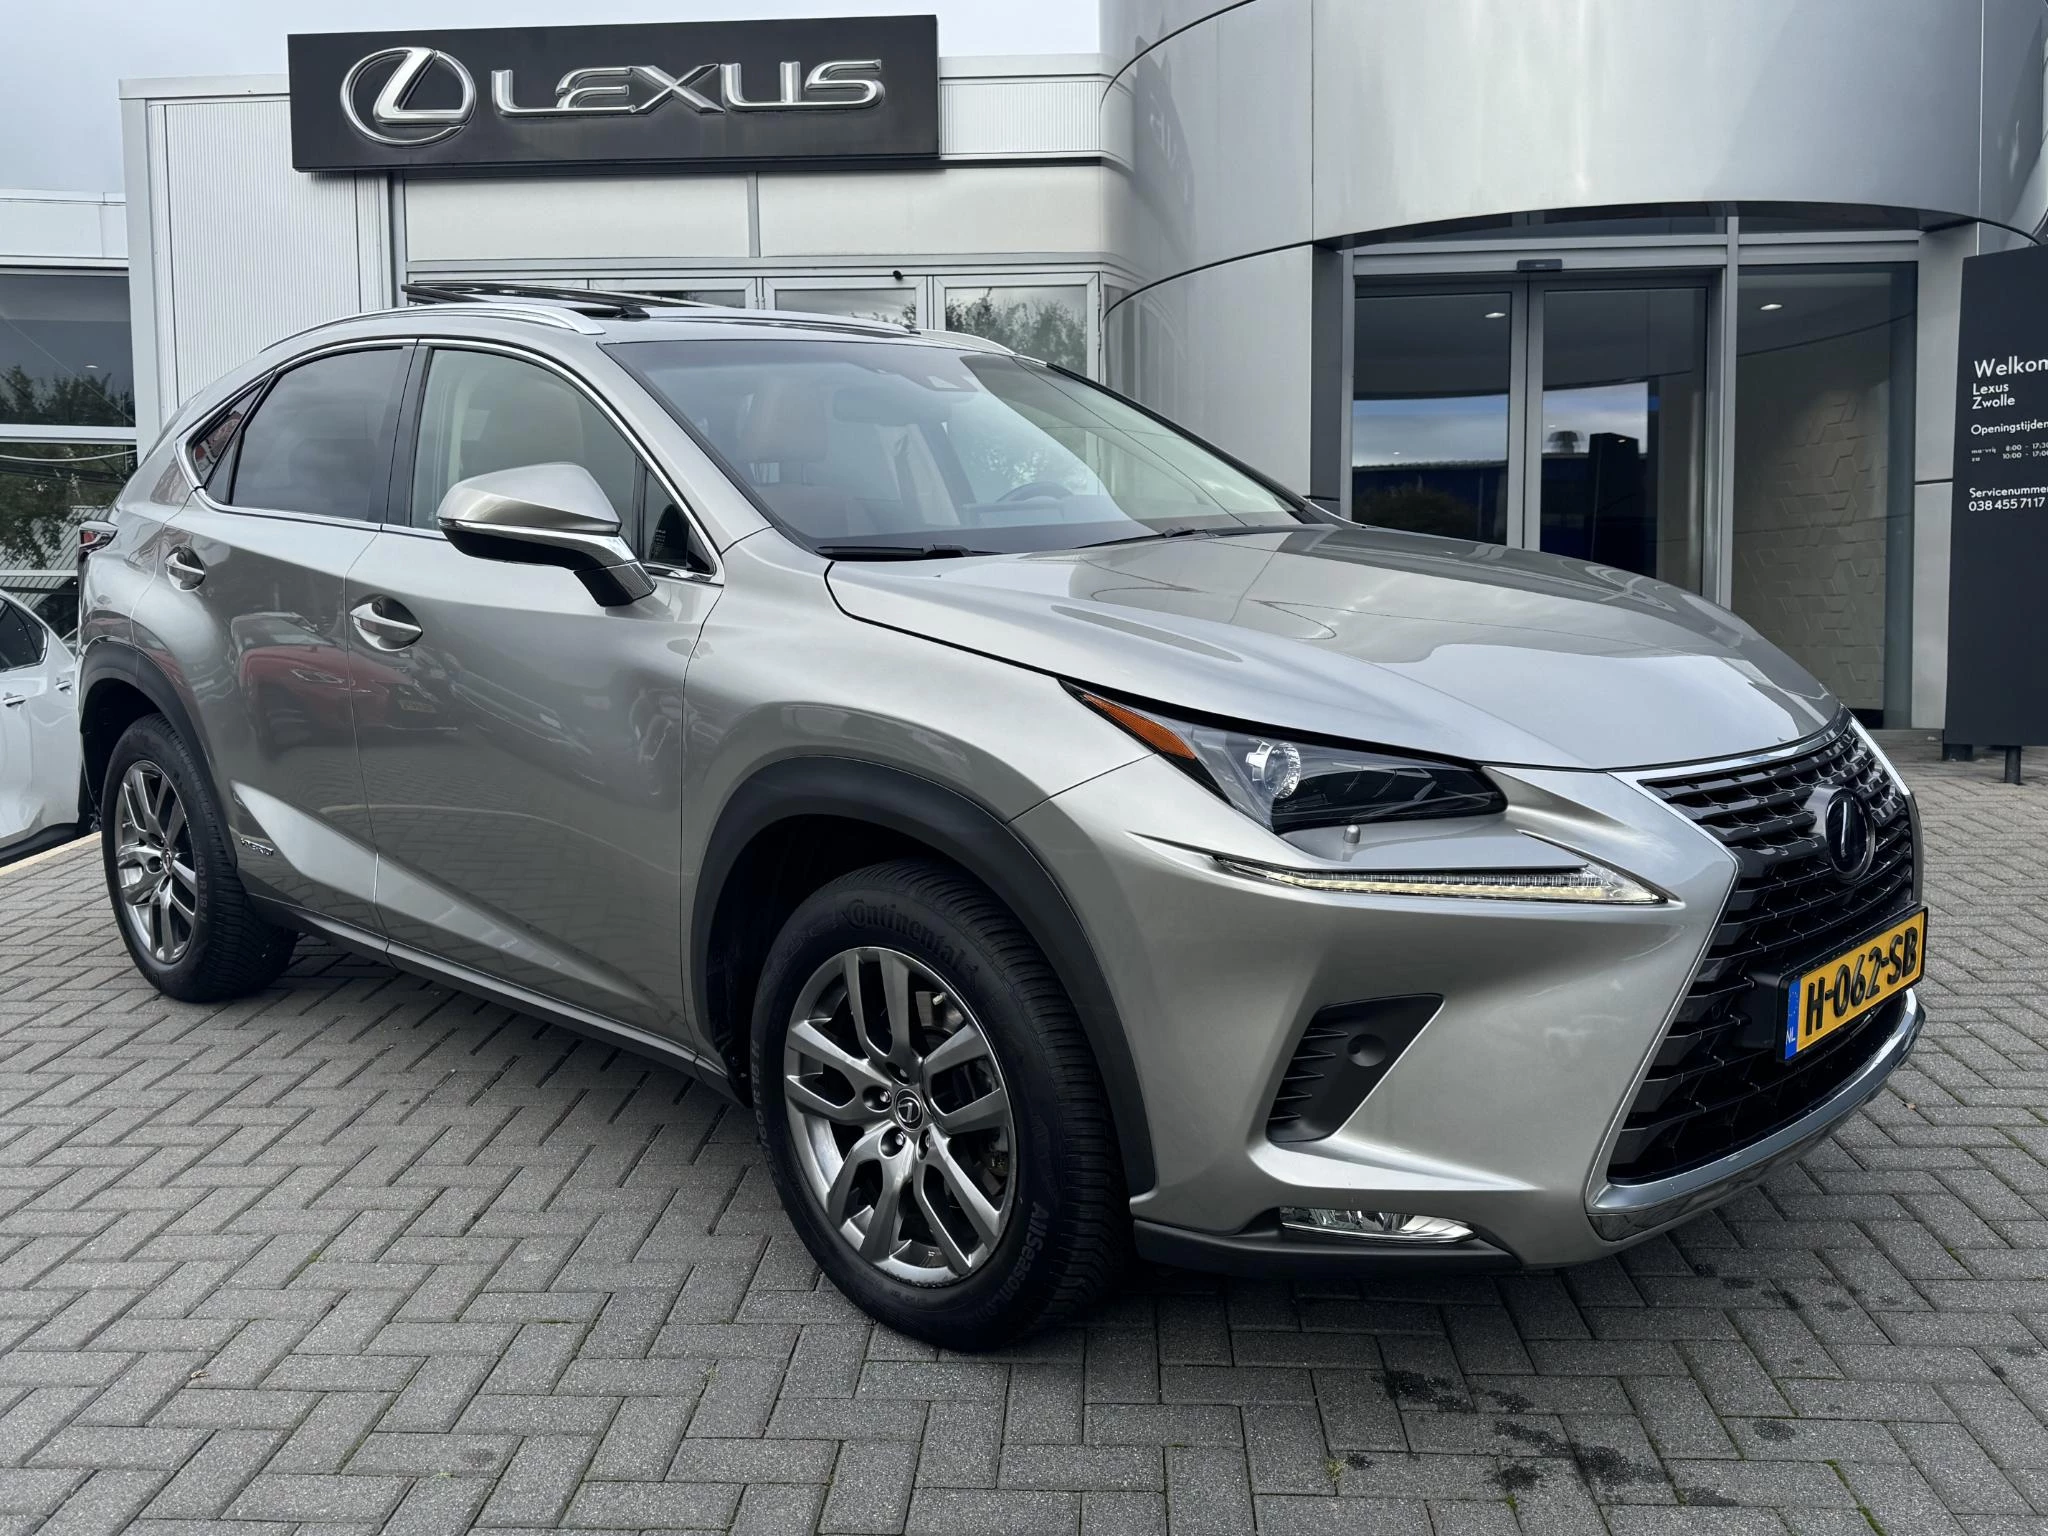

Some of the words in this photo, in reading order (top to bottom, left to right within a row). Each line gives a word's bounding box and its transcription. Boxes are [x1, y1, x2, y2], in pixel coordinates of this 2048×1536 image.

[491, 60, 886, 119] LEXUS
[1972, 382, 2010, 396] Lexus
[1972, 393, 2016, 410] Zwolle
[1968, 500, 1993, 512] 038
[1994, 498, 2018, 510] 455
[2020, 496, 2046, 509] 7117
[842, 899, 967, 972] Continental
[1805, 926, 1919, 1037] H-062-SB
